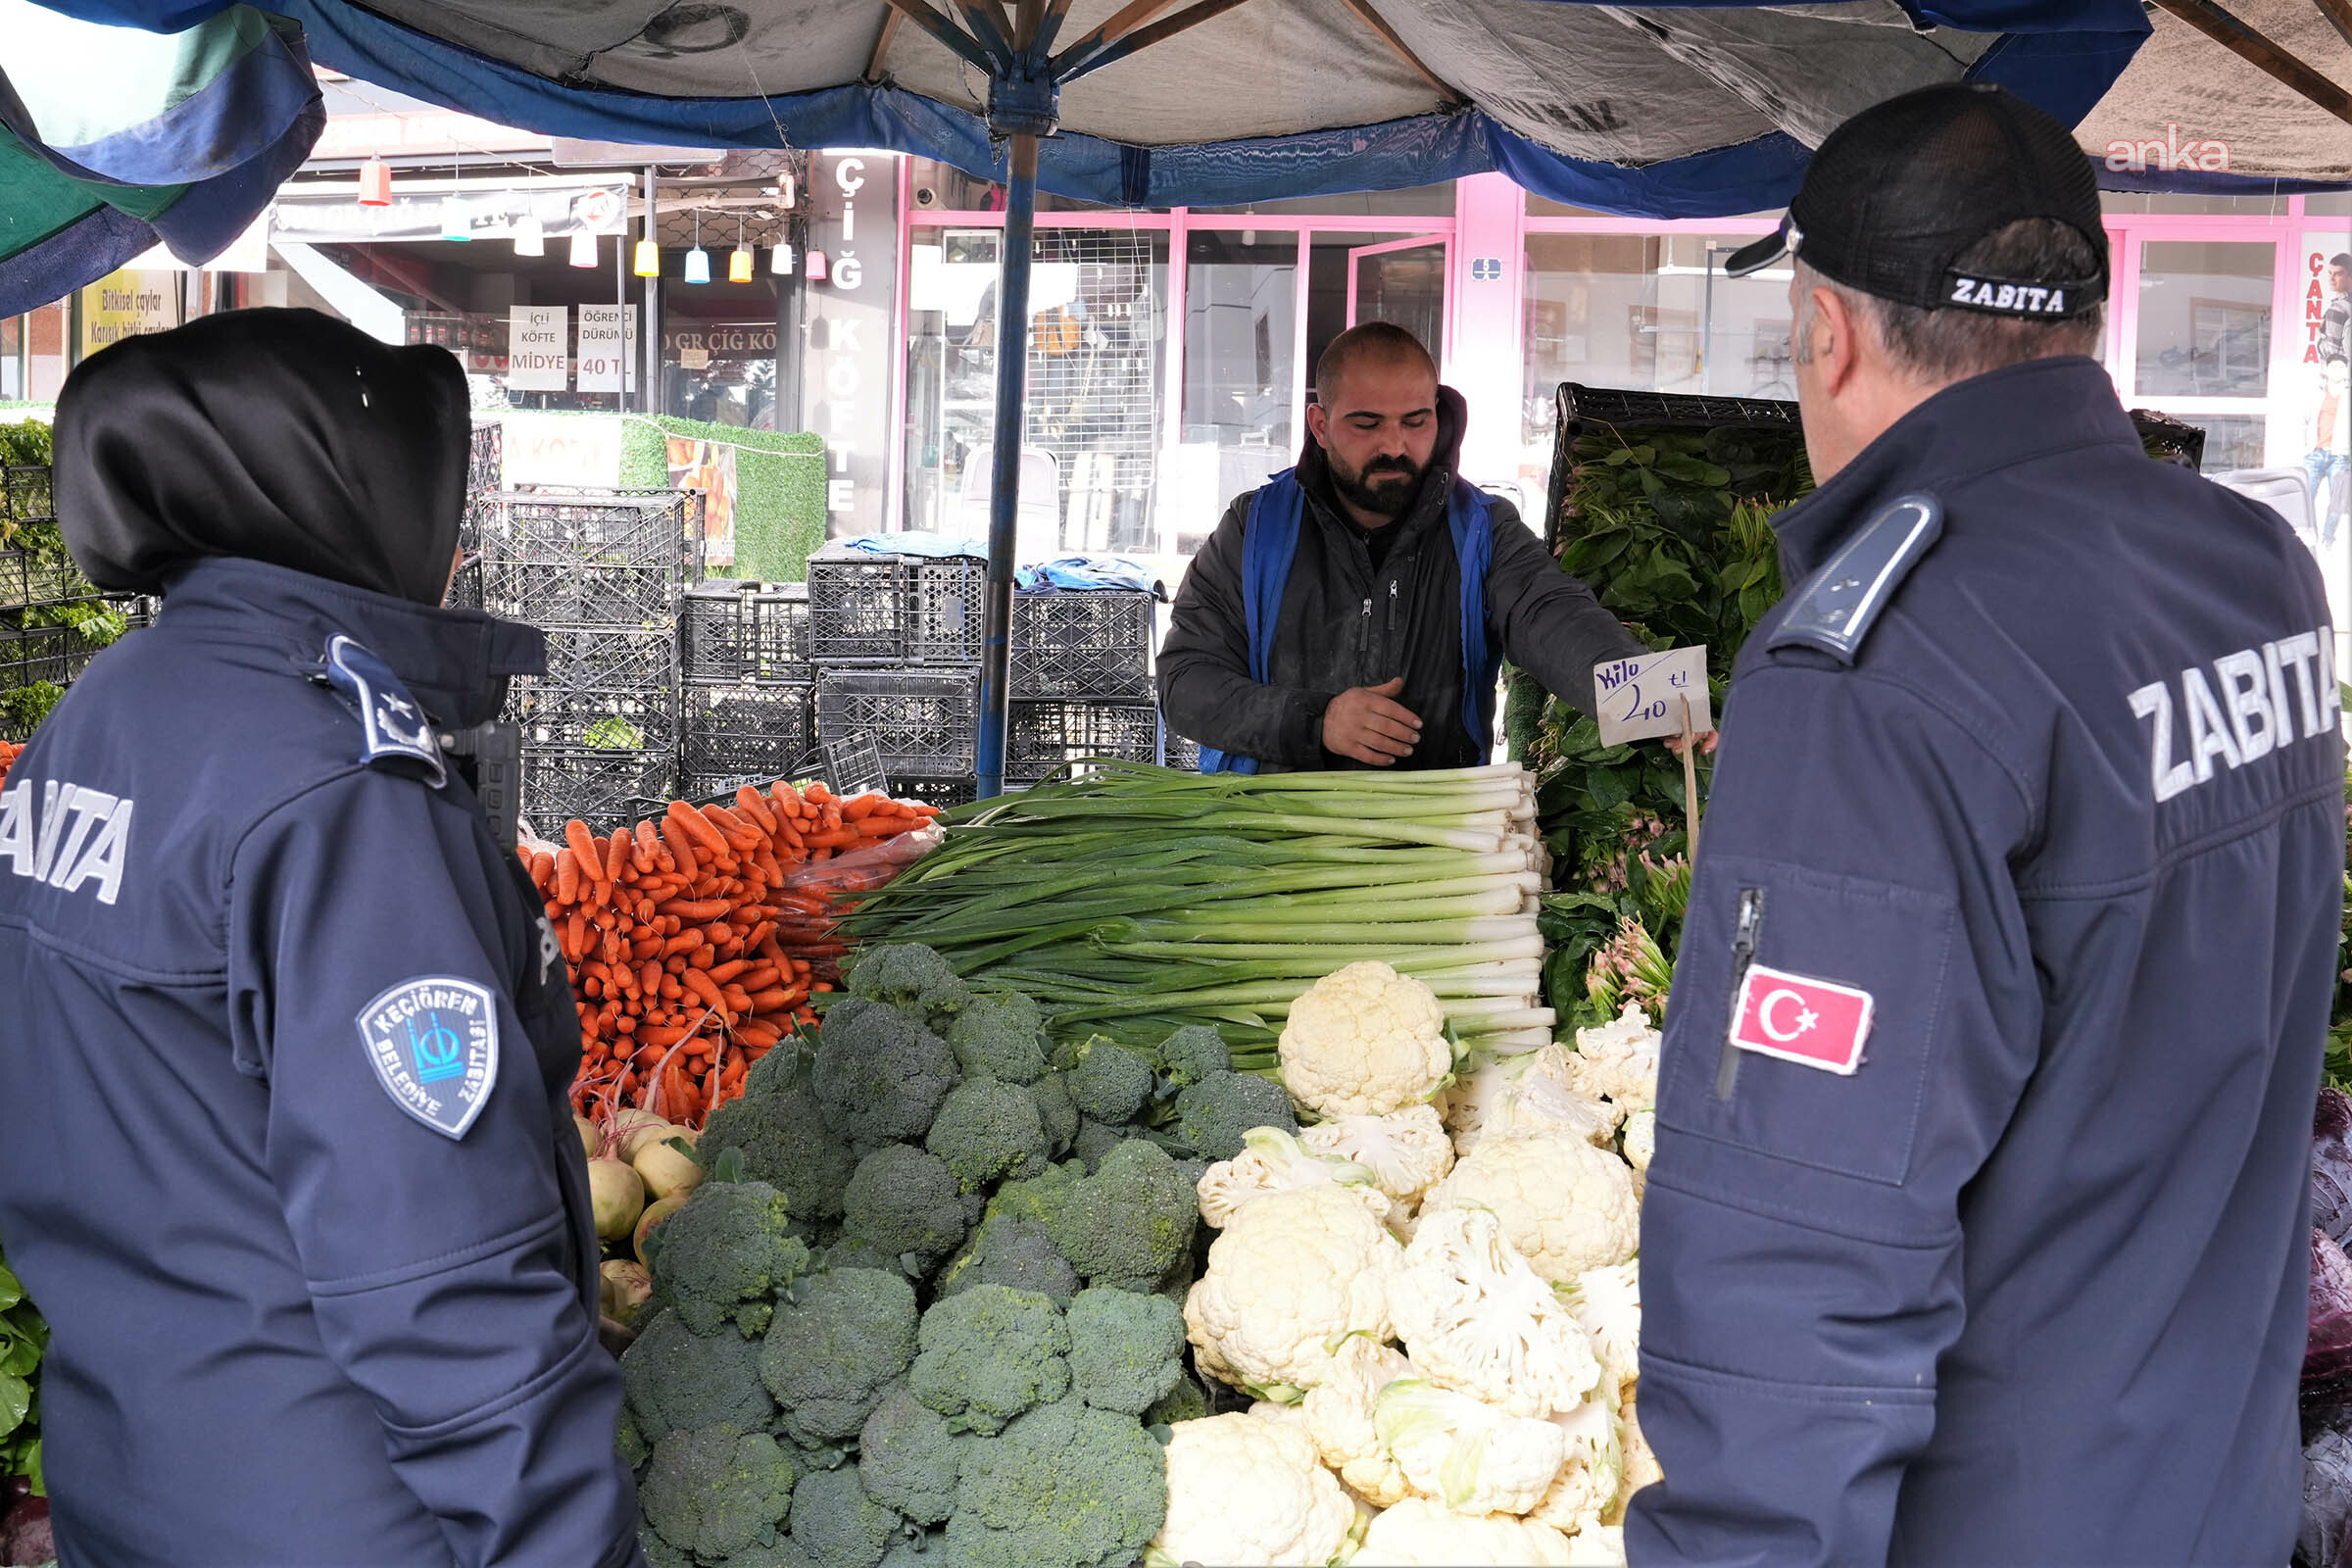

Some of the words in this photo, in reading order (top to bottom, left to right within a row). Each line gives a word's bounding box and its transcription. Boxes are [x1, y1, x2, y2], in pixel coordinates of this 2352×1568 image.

[832, 158, 865, 290] ÇİĞ
[102, 291, 132, 311] Bitkisel
[136, 291, 161, 317] çaylar
[1951, 278, 2064, 313] ZABITA
[2303, 253, 2325, 365] ÇANTA
[530, 312, 550, 326] İÇLİ
[521, 330, 556, 343] KÖFTE
[708, 329, 744, 356] ÇİĞ
[512, 352, 565, 369] MİDYE
[582, 359, 606, 374] 40
[827, 319, 863, 512] KÖFTE
[373, 985, 478, 1034] KEÇİÖREN
[375, 1038, 442, 1117] BELEDİYE
